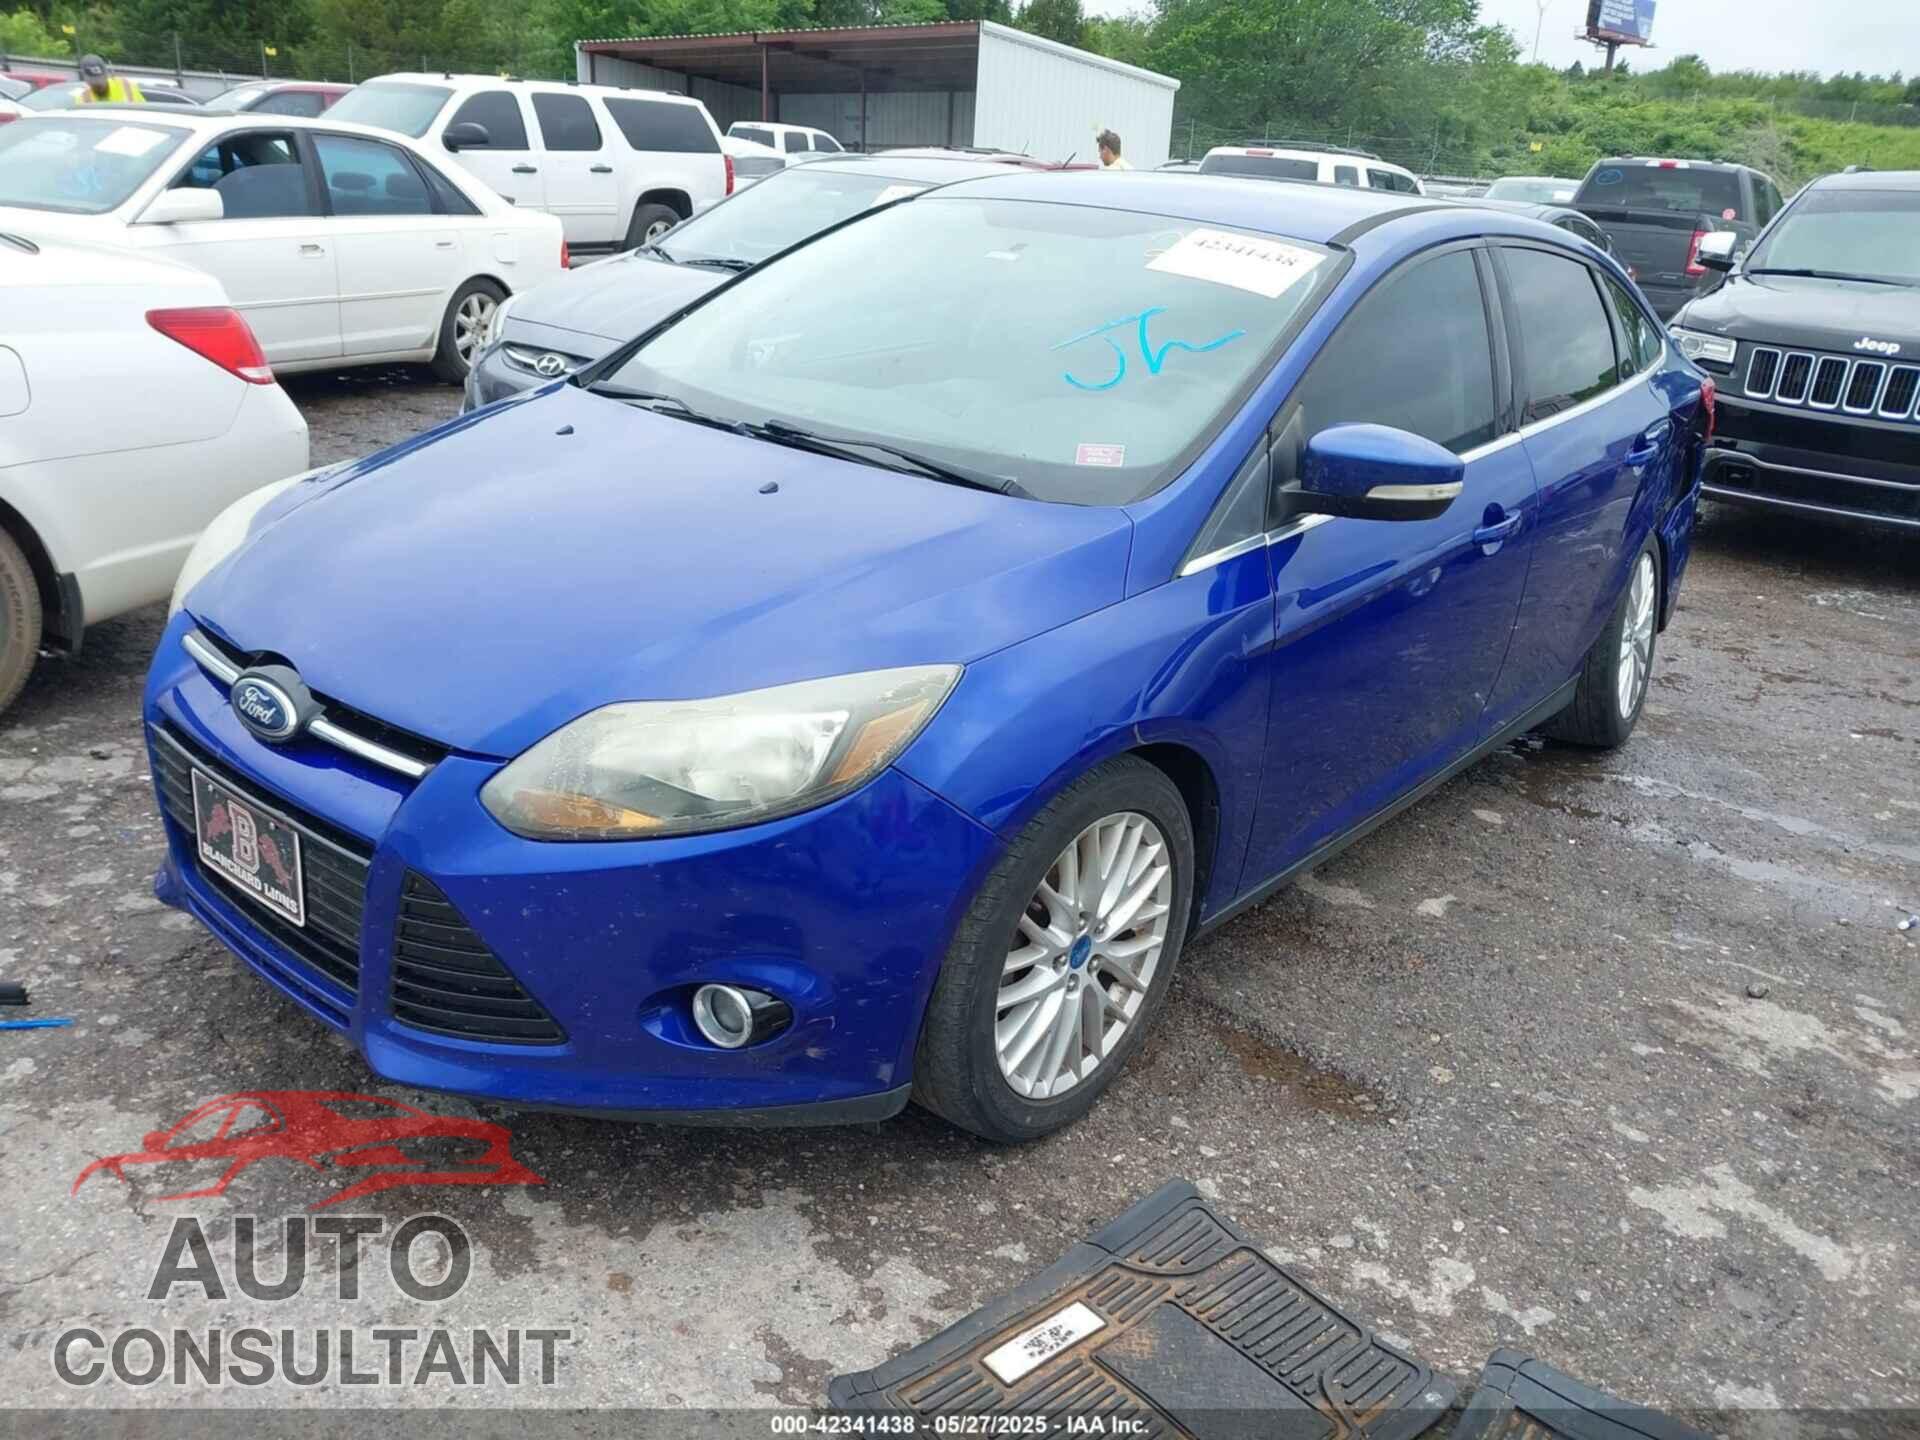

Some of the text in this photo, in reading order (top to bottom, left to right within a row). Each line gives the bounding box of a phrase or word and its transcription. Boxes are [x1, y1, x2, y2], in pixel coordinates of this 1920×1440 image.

[1853, 337, 1901, 355] Jeep
[239, 686, 277, 725] Ford
[227, 799, 260, 875] B
[202, 841, 262, 892] BLANCHARD
